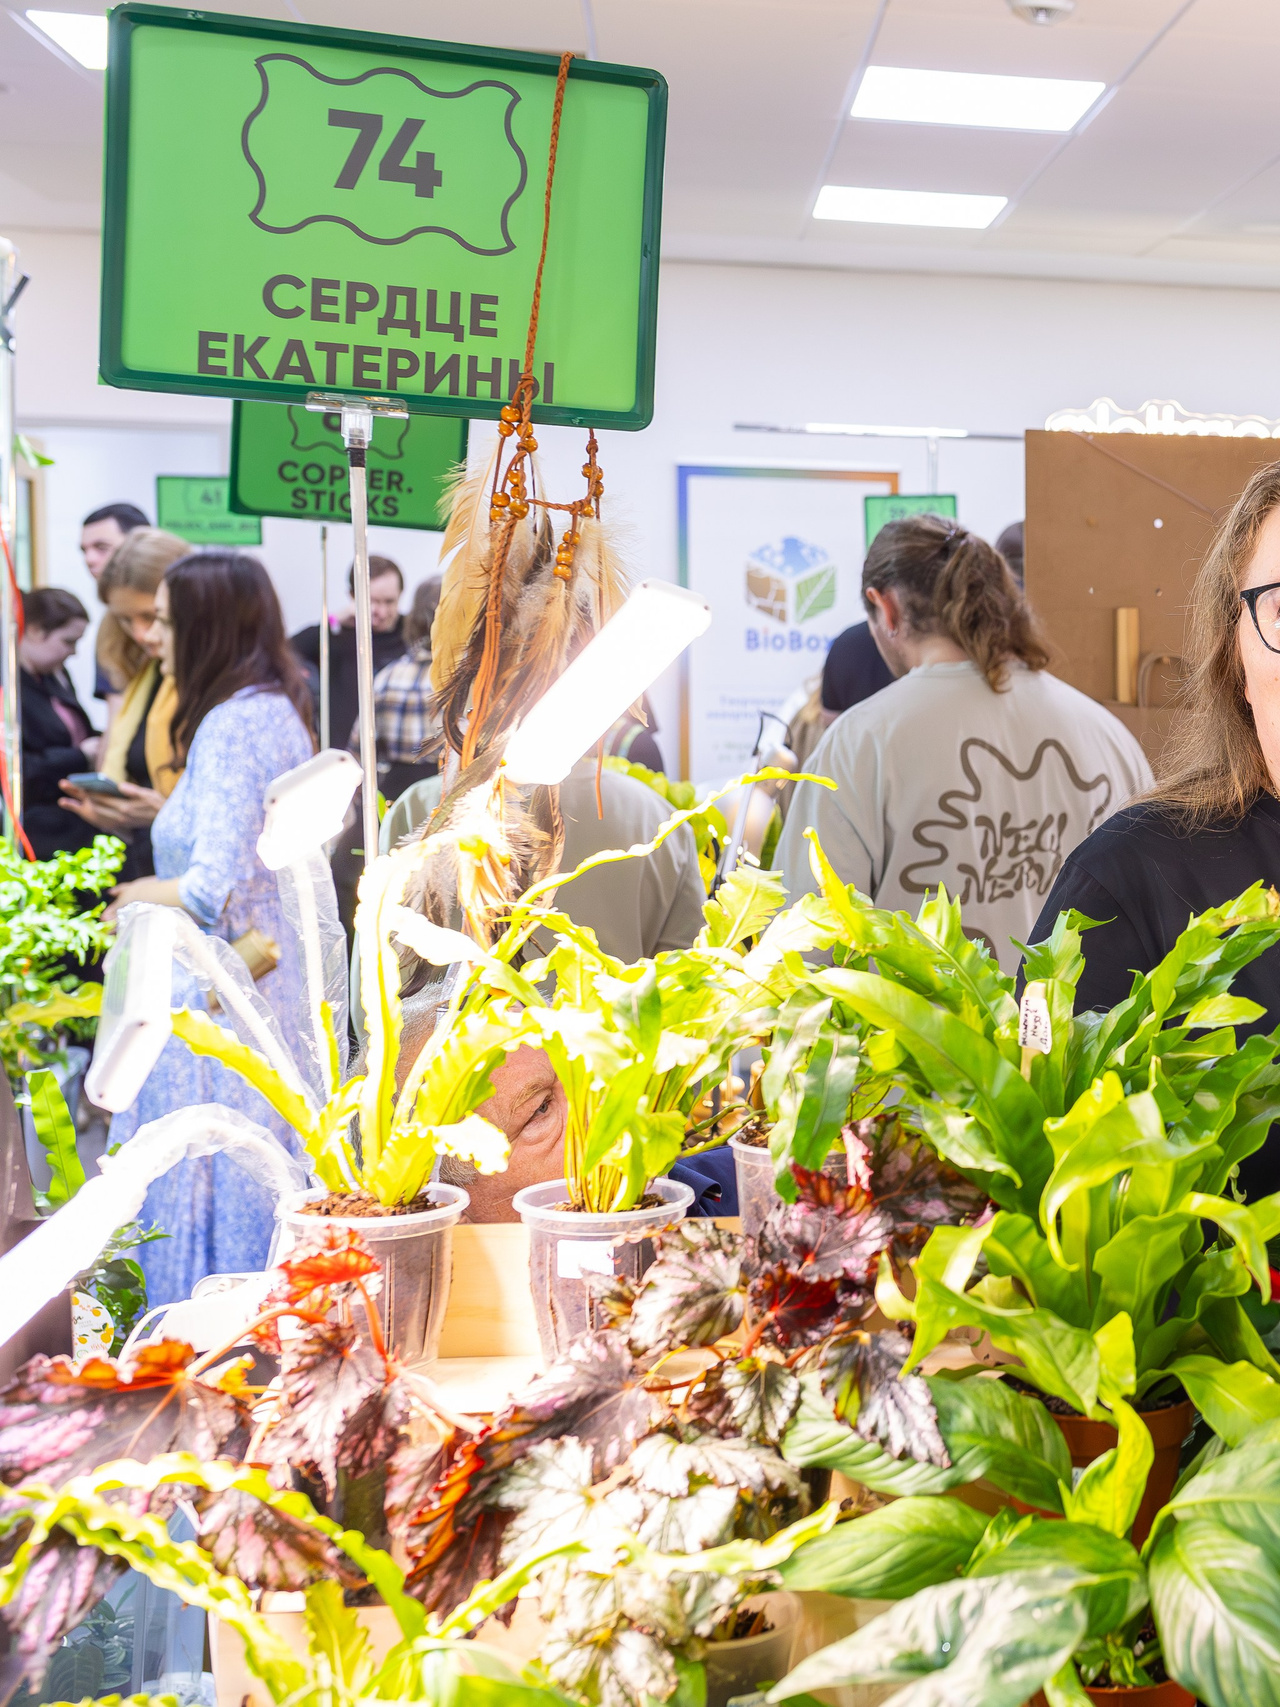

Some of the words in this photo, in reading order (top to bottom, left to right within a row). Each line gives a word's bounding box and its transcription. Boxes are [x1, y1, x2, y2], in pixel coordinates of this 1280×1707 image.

[328, 108, 443, 198] 74
[261, 273, 499, 342] СЕРДЦЕ
[197, 330, 554, 404] ЕКАТЕРИНЫ
[277, 460, 413, 494] COPER.
